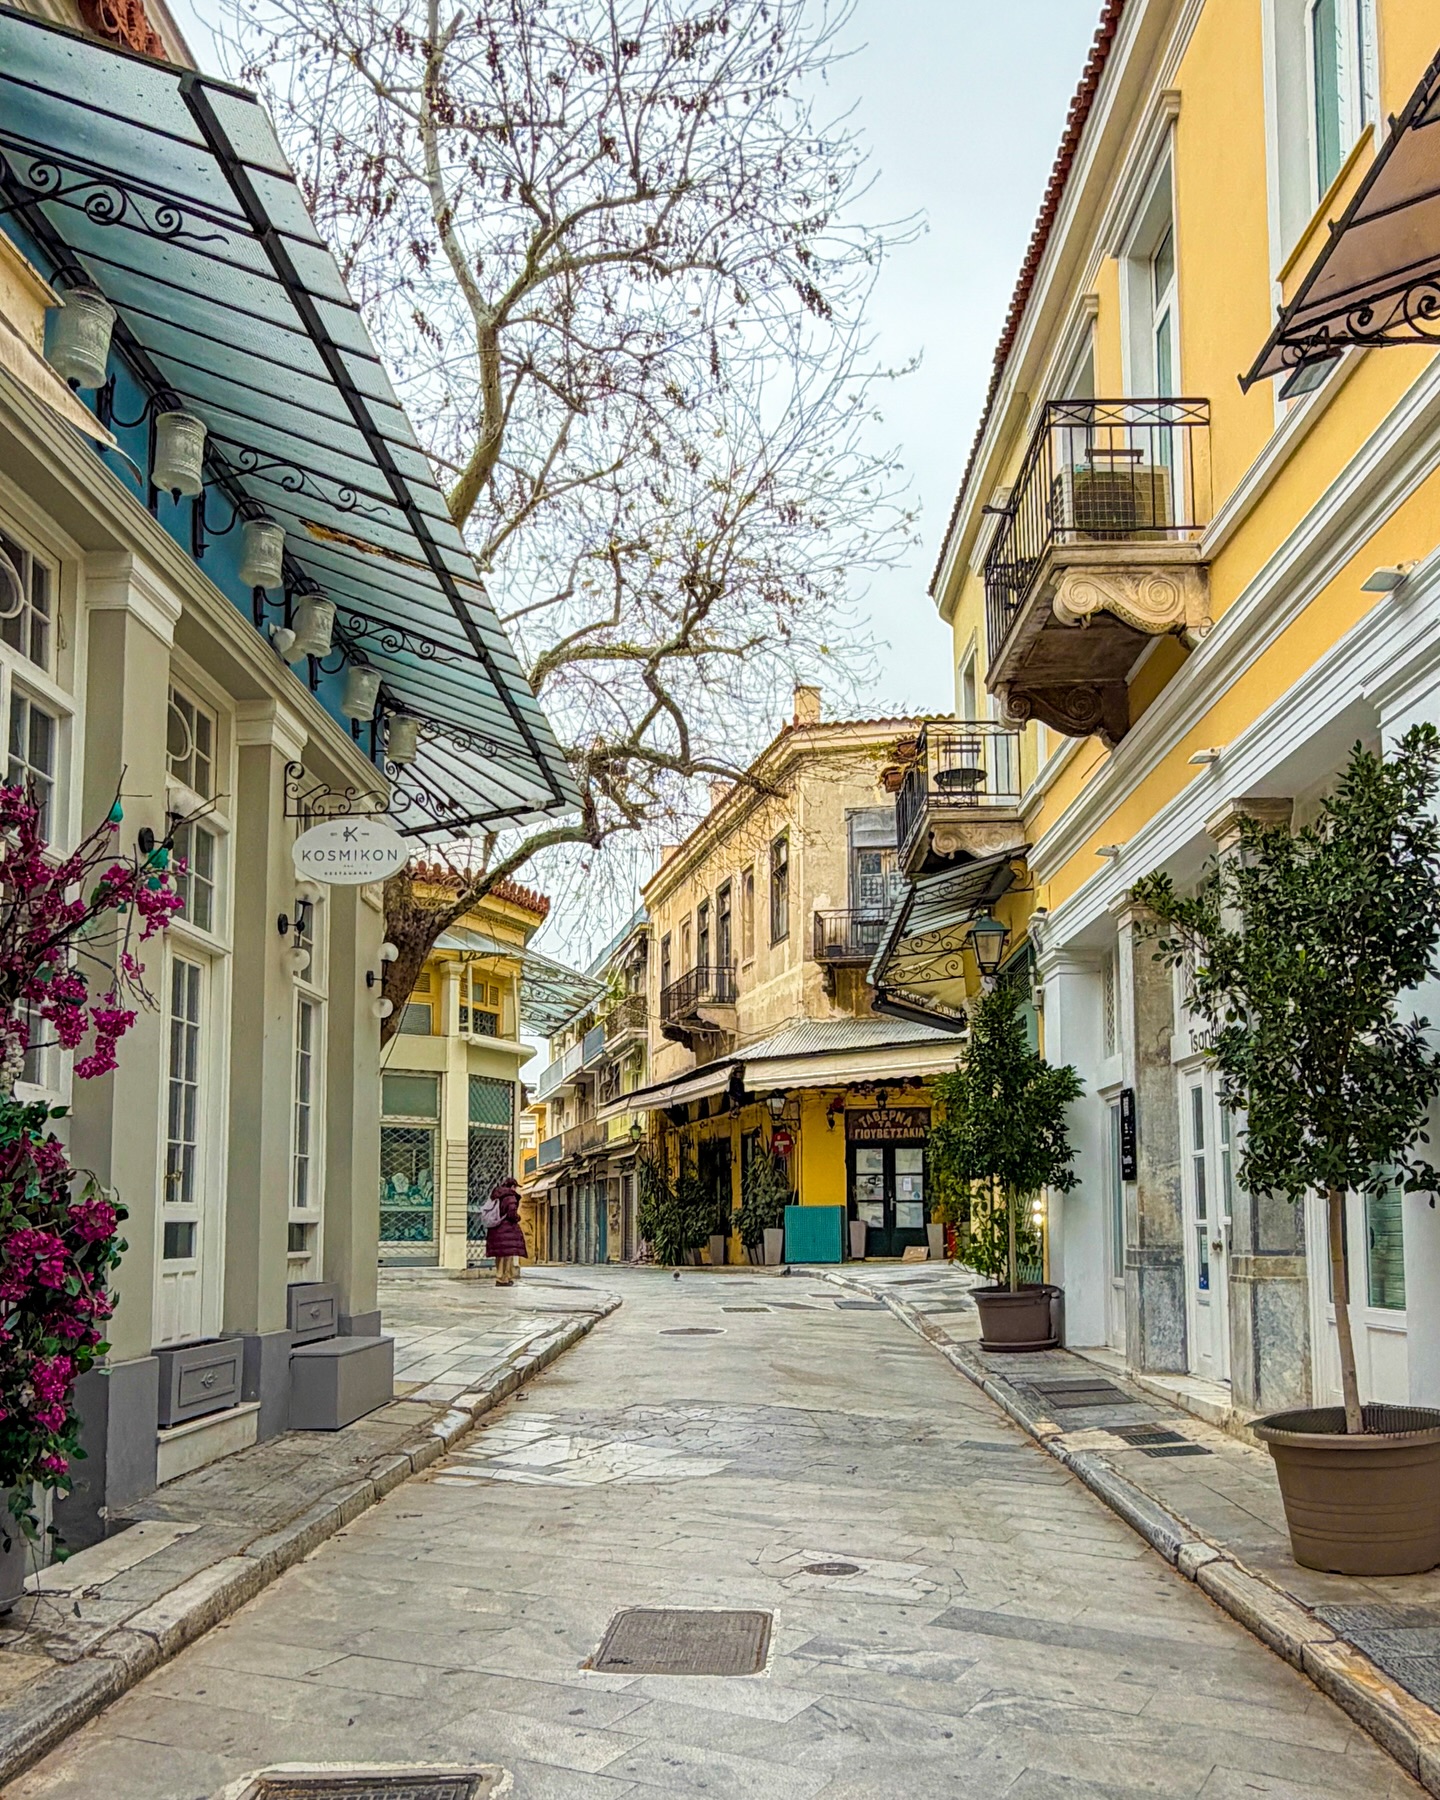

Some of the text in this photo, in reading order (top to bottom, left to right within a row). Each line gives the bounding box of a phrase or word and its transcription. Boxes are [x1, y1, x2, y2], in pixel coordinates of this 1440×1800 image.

[302, 849, 398, 861] KOSMIKON
[858, 1110, 912, 1128] ΤΑΒΕΡΝΑ
[878, 1120, 892, 1128] ΤΑ
[855, 1127, 925, 1139] ΓΙΟΥΒΕΤΣΑΚΙΑ
